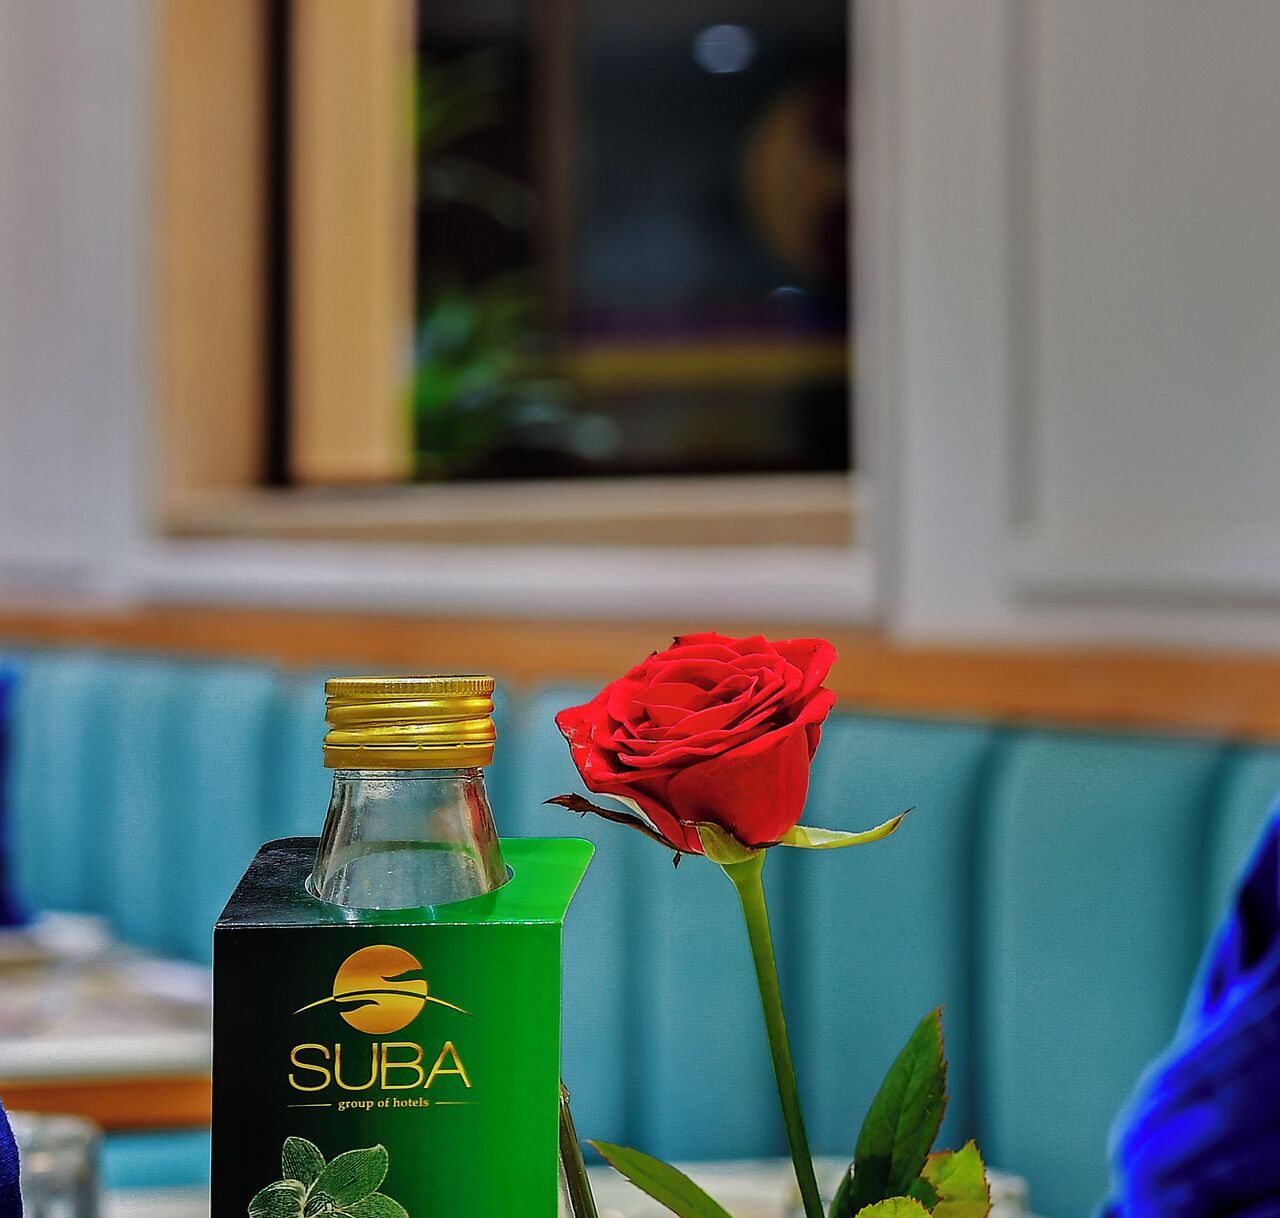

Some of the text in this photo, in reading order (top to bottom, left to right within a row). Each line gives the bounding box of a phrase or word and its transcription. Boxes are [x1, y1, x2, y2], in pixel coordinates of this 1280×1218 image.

[288, 1041, 472, 1091] SUBA
[337, 1096, 429, 1111] group of hotels
